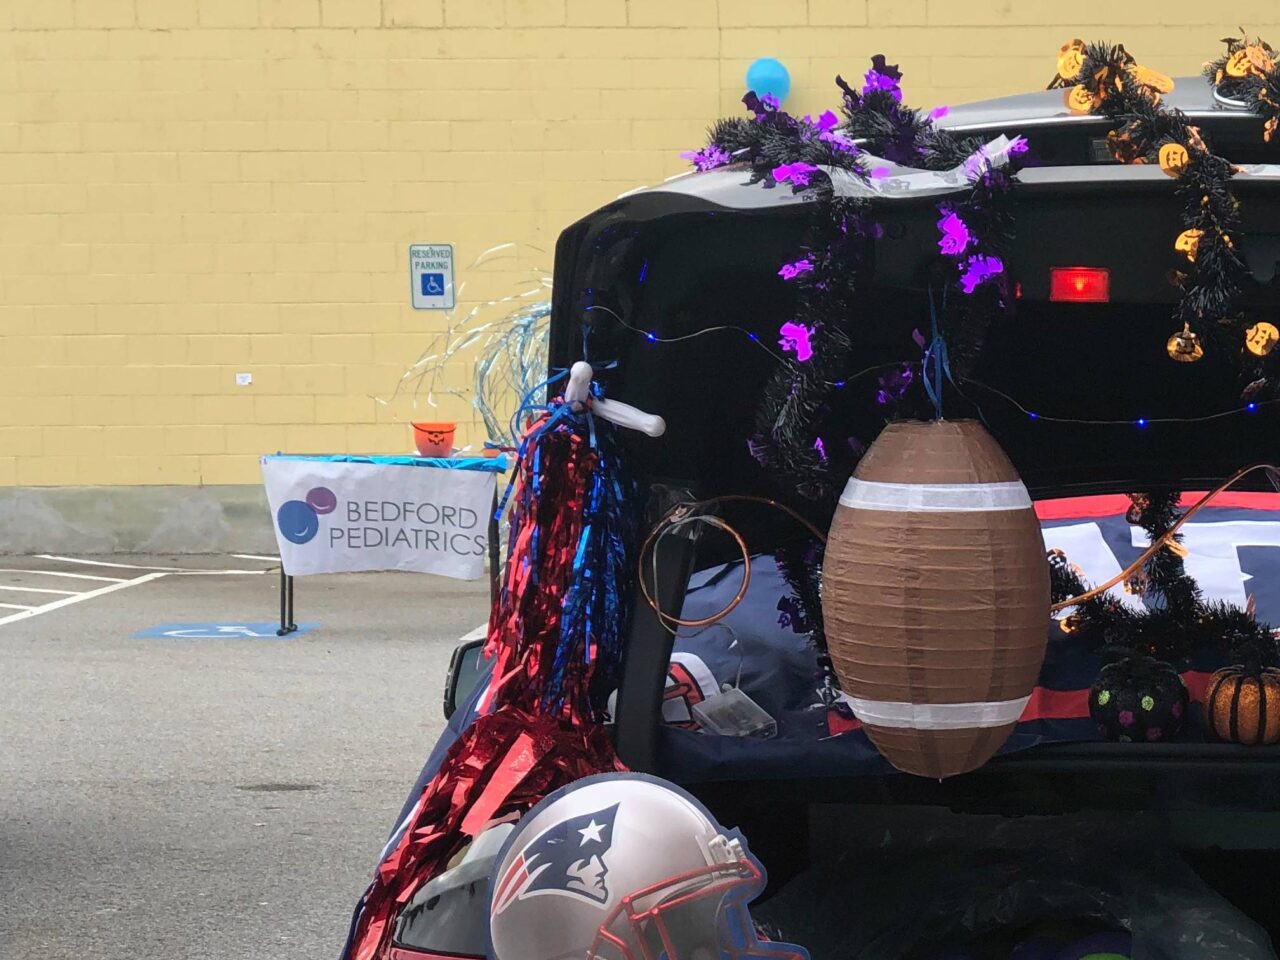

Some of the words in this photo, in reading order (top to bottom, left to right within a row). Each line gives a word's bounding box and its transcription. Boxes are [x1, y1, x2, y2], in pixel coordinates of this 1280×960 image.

[412, 249, 451, 259] RESERVED
[415, 261, 448, 270] PARKING
[346, 501, 478, 529] BEDFORD
[330, 527, 486, 556] PEDIATRICS
